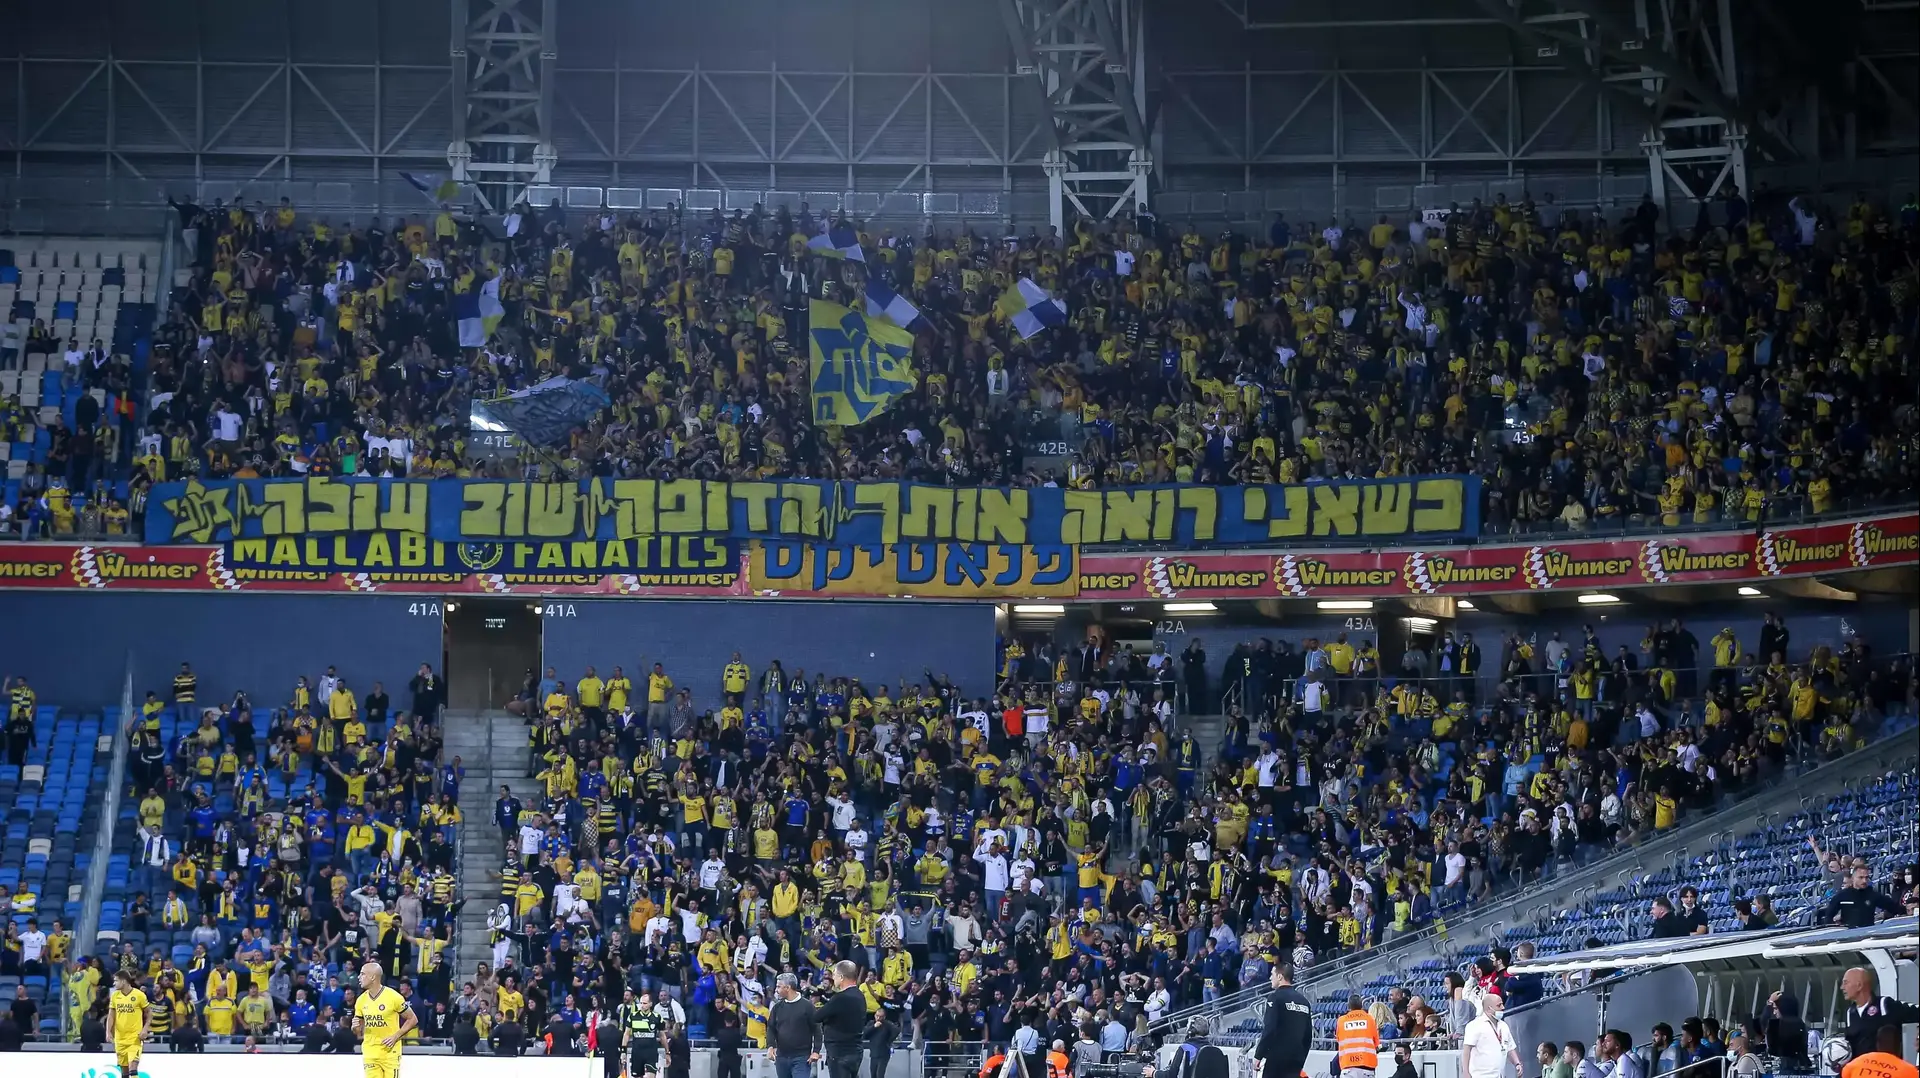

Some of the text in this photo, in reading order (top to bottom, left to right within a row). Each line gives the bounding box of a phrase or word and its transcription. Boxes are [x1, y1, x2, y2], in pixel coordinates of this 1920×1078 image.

[1039, 442, 1068, 455] 42B
[262, 476, 428, 536] עולה
[460, 481, 578, 537] שוב
[855, 482, 1029, 544] אותך
[1061, 487, 1217, 544] רואה
[1244, 479, 1463, 538] כשאני
[514, 535, 728, 568] FANATICS
[1660, 547, 1750, 571] Winner
[1774, 539, 1844, 563] Winner
[96, 554, 199, 578] Winner
[759, 541, 1074, 591] פנאטיקס
[1167, 564, 1266, 588] Winner
[1298, 561, 1397, 585] Winner
[1426, 559, 1516, 582] Winner
[1544, 553, 1632, 577] Winner
[408, 603, 439, 616] 41A
[545, 604, 577, 617] 41A
[1155, 620, 1185, 633] 42A
[1344, 617, 1374, 630] 43A
[1243, 658, 1251, 677] FILA
